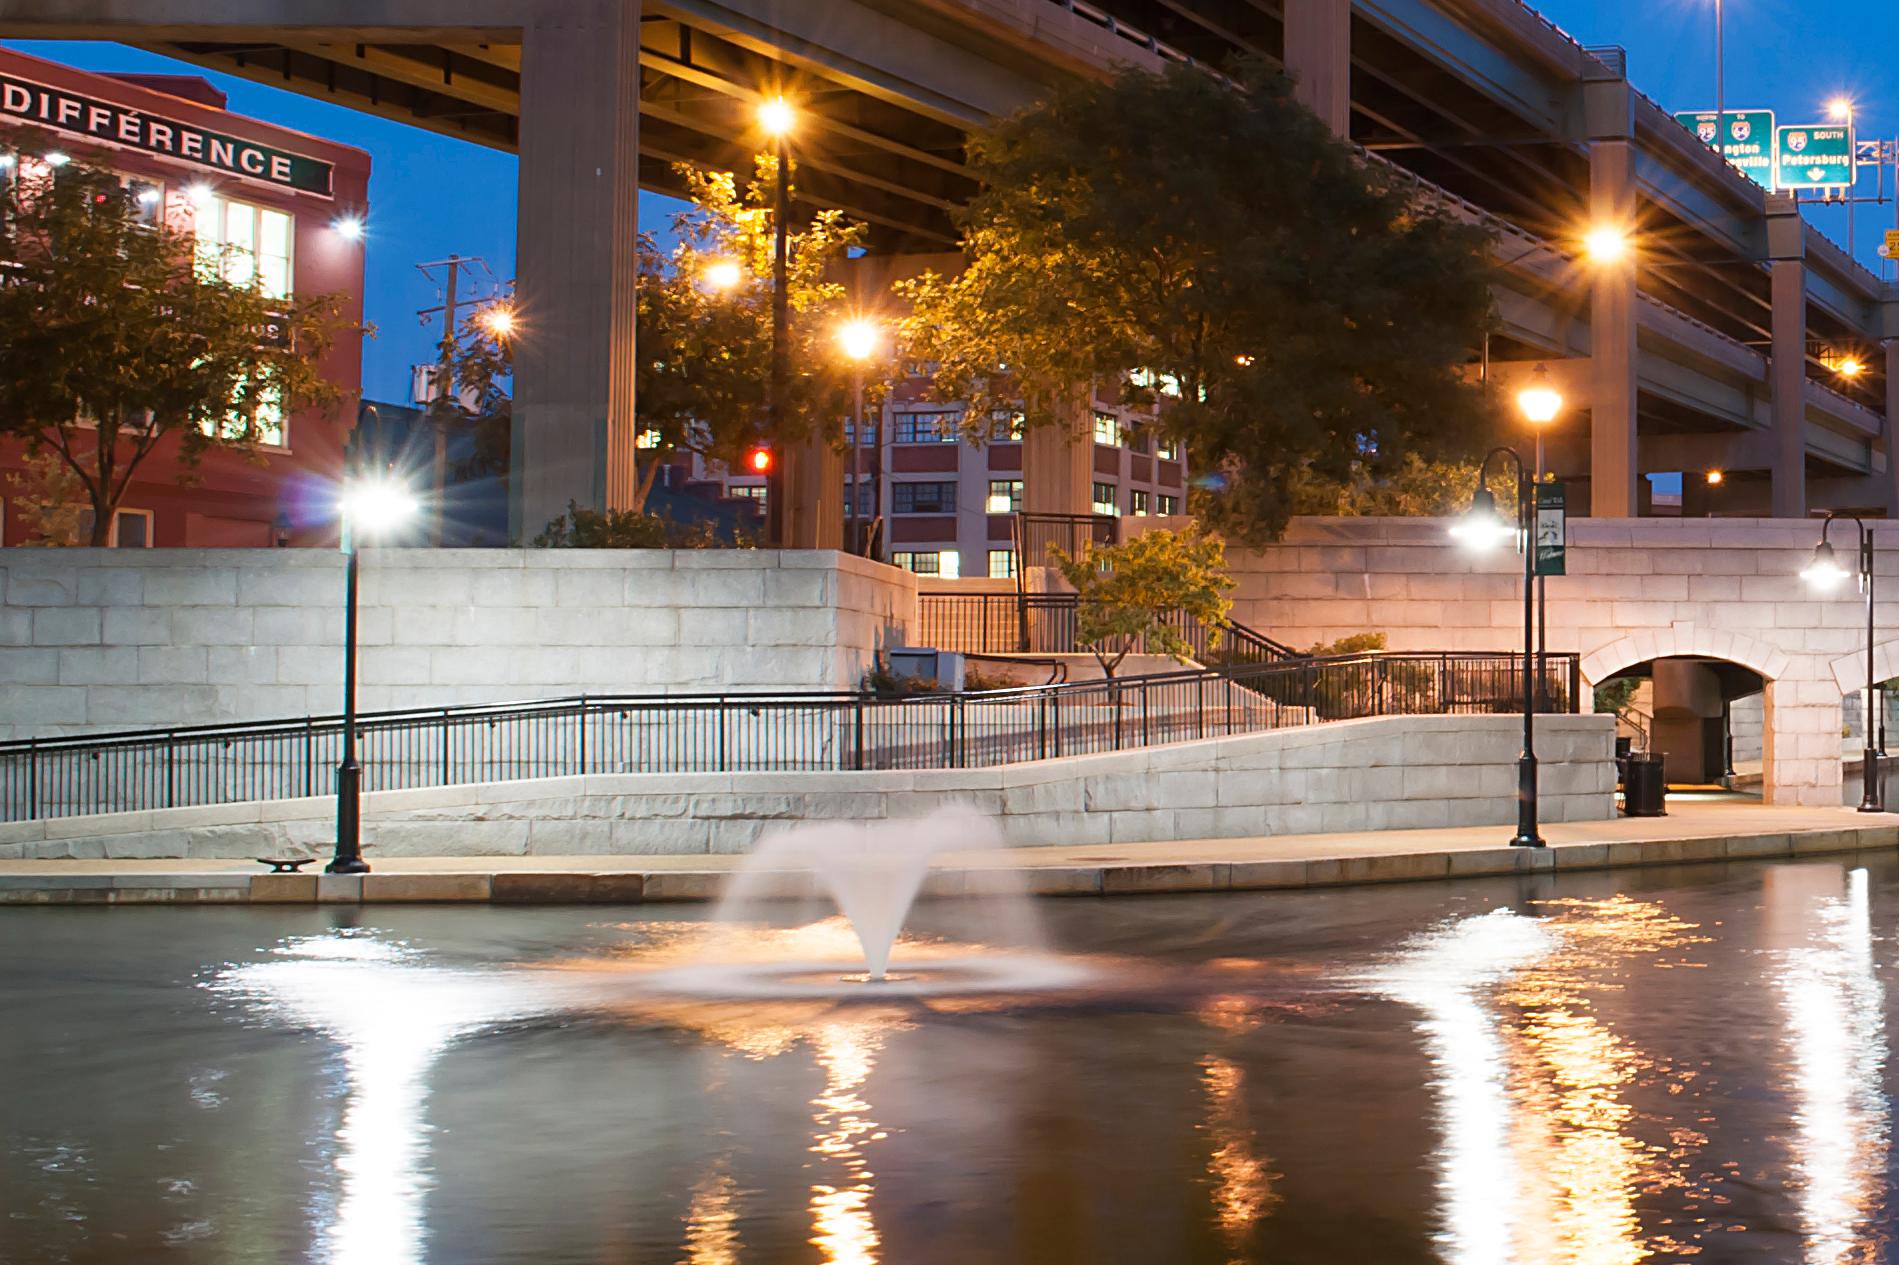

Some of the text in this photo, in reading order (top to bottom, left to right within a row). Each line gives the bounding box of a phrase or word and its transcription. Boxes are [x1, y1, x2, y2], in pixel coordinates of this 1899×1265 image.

[2, 82, 292, 183] DIFFÉRENCE
[1813, 131, 1844, 140] SOUTH
[1789, 136, 1805, 148] 95
[1782, 153, 1849, 167] Petersburg
